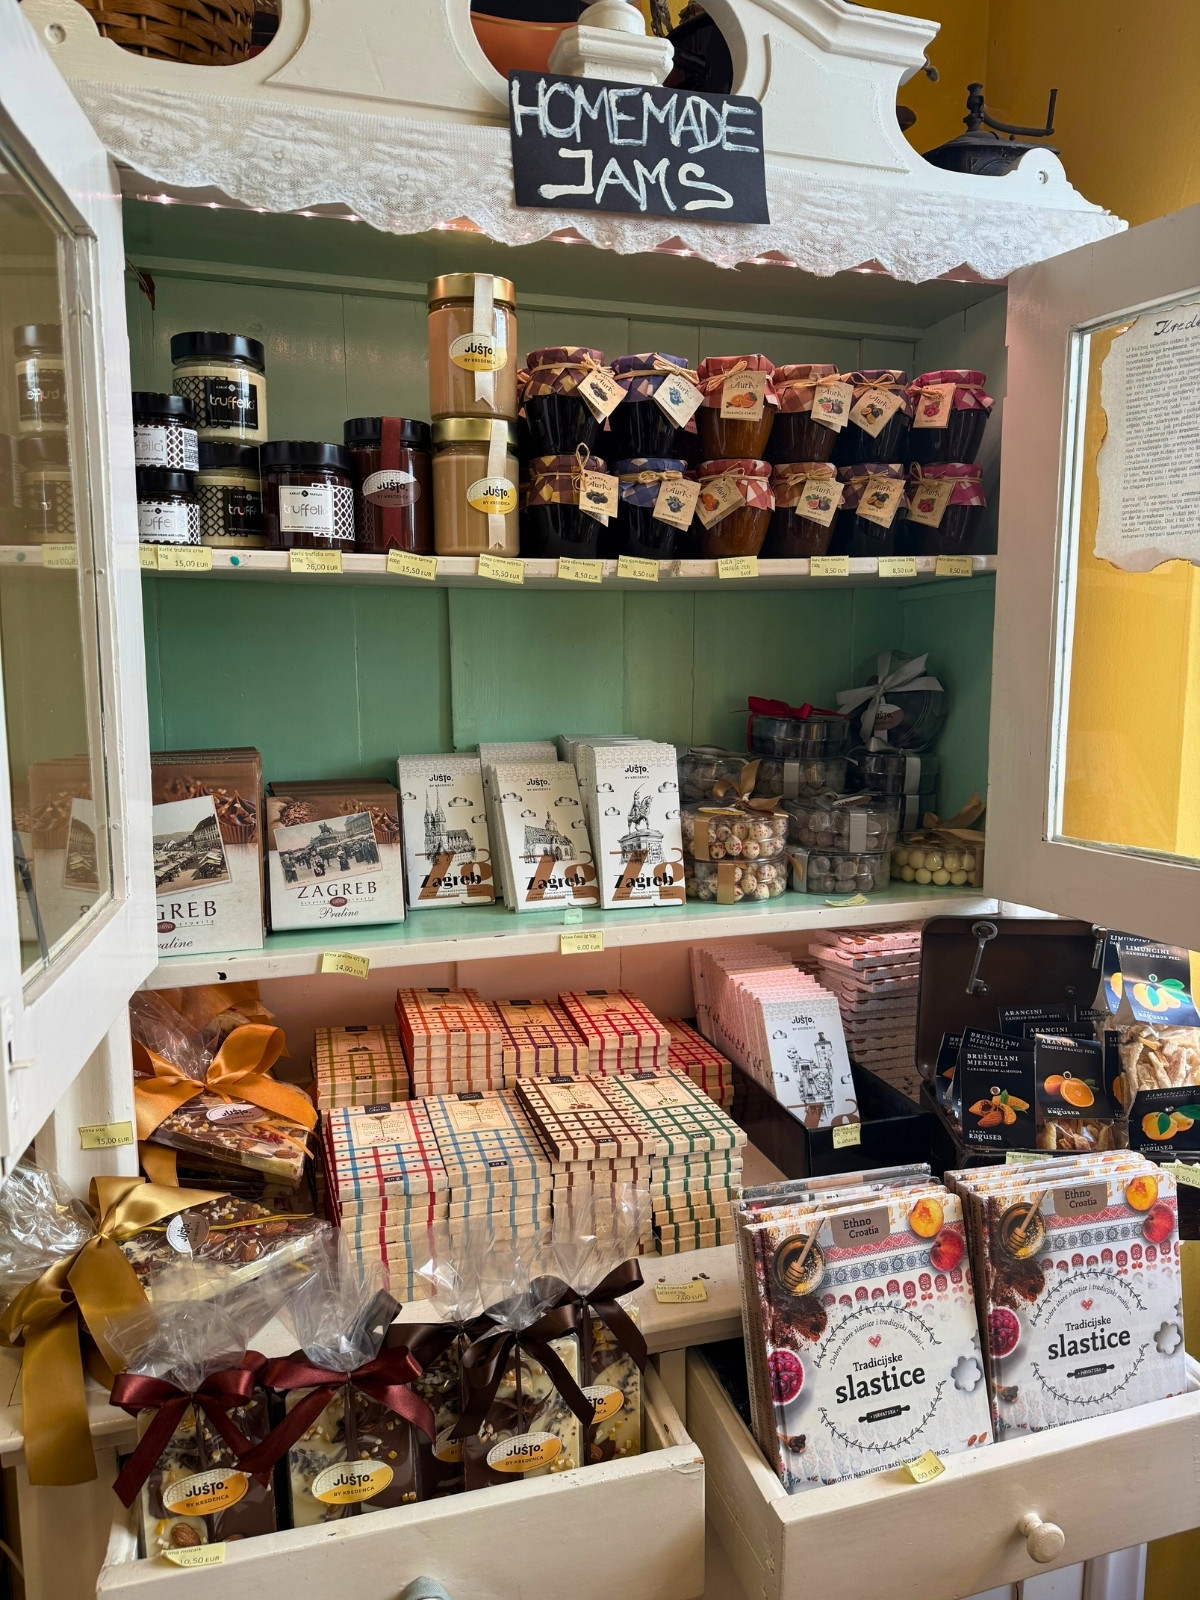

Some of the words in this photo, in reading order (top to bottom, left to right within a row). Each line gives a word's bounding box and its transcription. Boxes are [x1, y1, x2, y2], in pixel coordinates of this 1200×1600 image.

[512, 76, 759, 153] HOMEMADE
[538, 147, 734, 212] JAMS
[175, 560, 195, 568] 15,00
[306, 564, 326, 572] 26,00
[402, 565, 420, 576] 15,50
[420, 570, 432, 578] EUR
[492, 569, 508, 578] 15,50
[574, 572, 588, 580] 8,50
[632, 570, 646, 578] 8,50
[419, 872, 482, 891] Zagreb
[525, 873, 586, 892] Zagreb
[614, 872, 674, 891] Zagreb
[297, 882, 377, 899] ZAGREB
[319, 906, 359, 919] Praline
[1126, 945, 1170, 955] LIMUNCINI
[353, 968, 364, 976] EUR
[969, 1037, 1009, 1051] MJENDULI
[970, 1031, 1020, 1048] BRUŠTULANI
[1041, 1038, 1078, 1048] ARANCINI
[966, 1052, 1019, 1062] BRUŠTULANI
[966, 1060, 1009, 1068] MJENDULI
[96, 1138, 117, 1146] 15,00
[1176, 1174, 1191, 1183] 8,50
[1064, 1188, 1091, 1200] Ethno
[1069, 1197, 1098, 1209] Croatia
[842, 1217, 872, 1230] Ethno
[848, 1224, 880, 1239] Croatia
[1064, 1316, 1112, 1332] Tradicijske
[1048, 1328, 1131, 1361] slastice
[852, 1352, 903, 1372] Tradicijske
[836, 1365, 926, 1404] slastice
[514, 1456, 544, 1464] KREDENCA
[928, 1466, 940, 1475] EUR
[342, 1486, 374, 1496] KREDENCA
[196, 1494, 230, 1506] KREDENCA
[180, 1557, 204, 1566] 10,50
